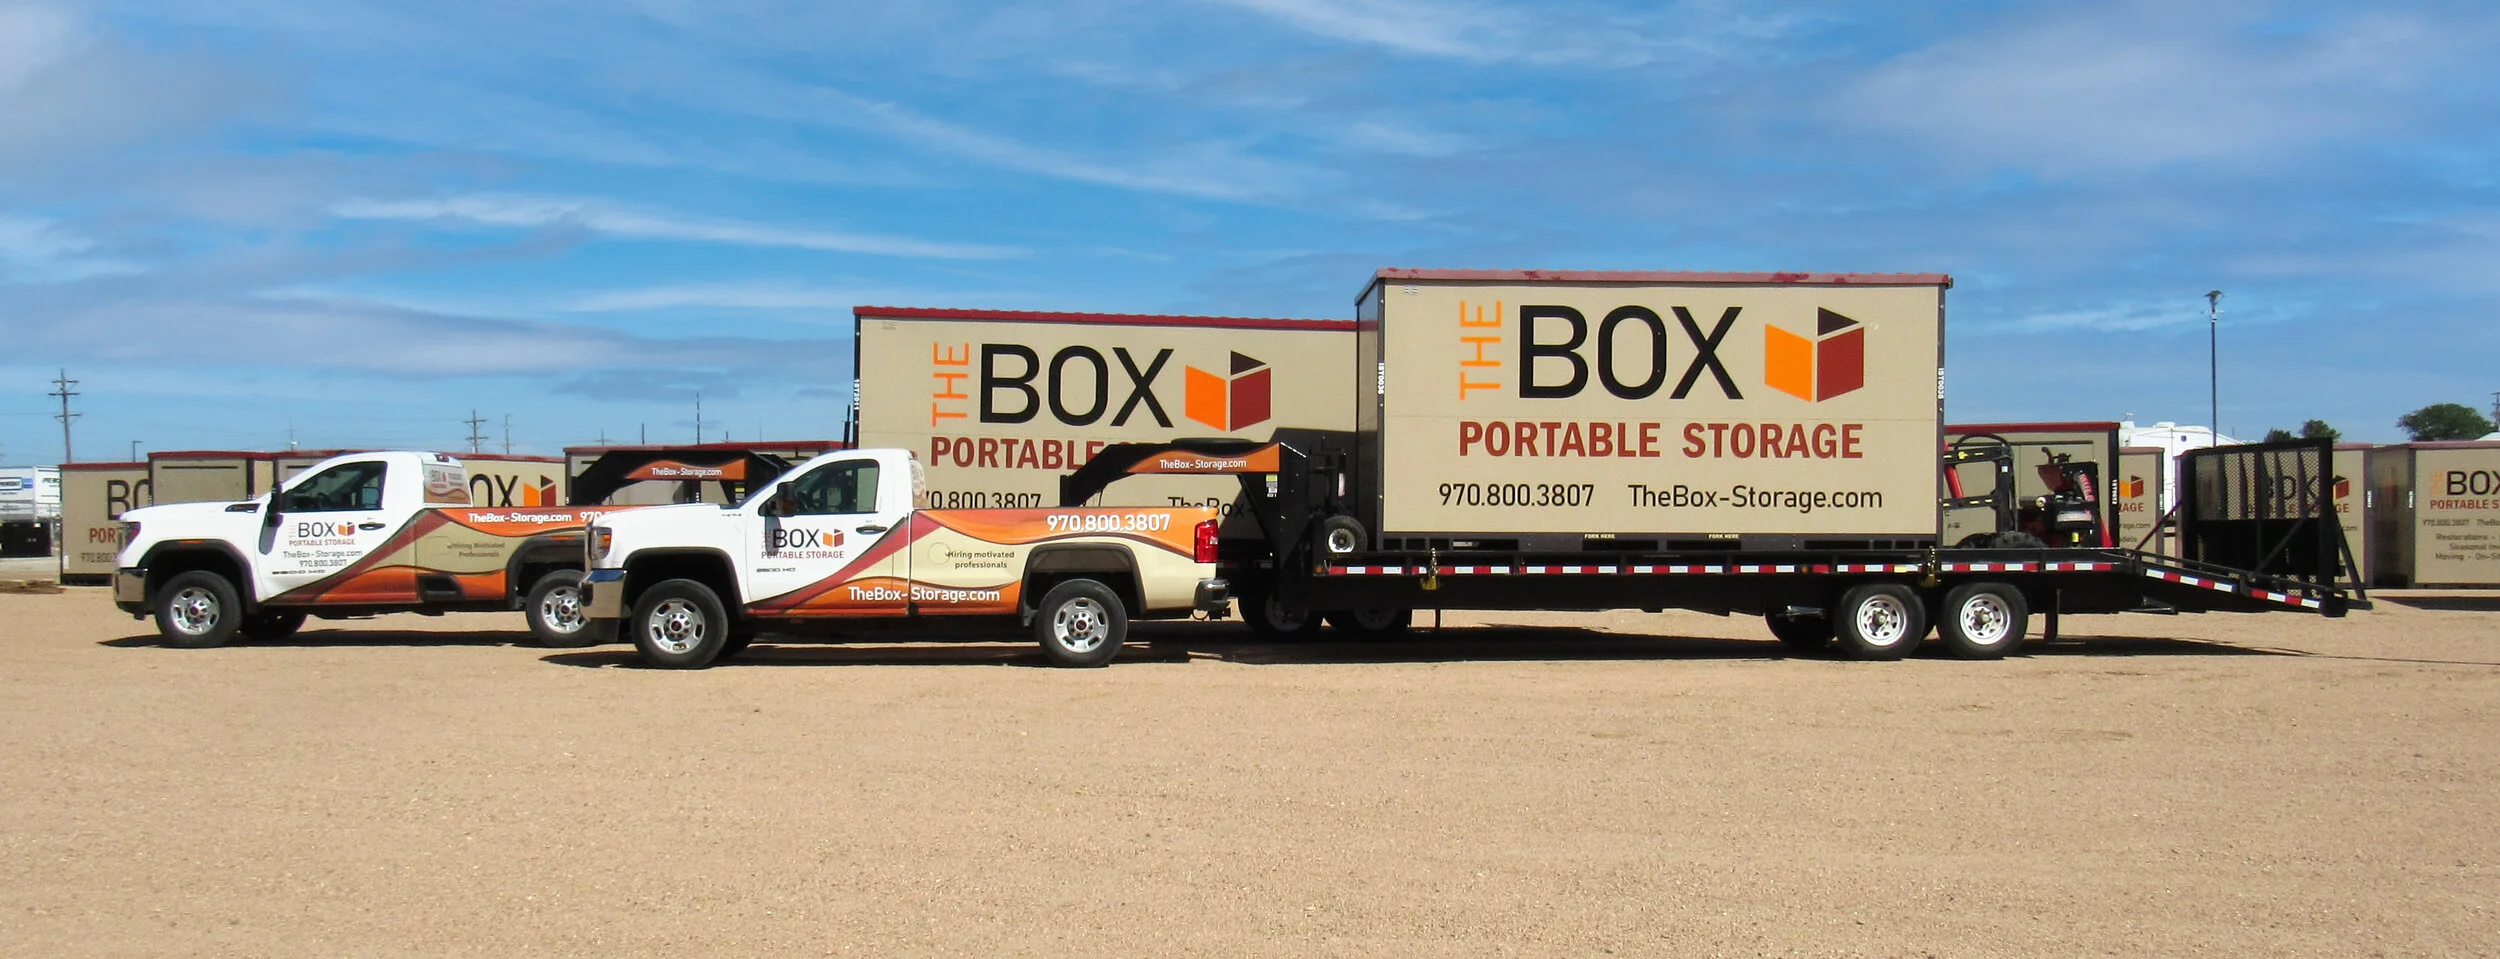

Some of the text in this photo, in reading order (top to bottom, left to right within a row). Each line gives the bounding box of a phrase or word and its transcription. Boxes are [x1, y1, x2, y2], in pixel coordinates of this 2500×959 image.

[1460, 300, 1502, 401] THE
[1519, 305, 1743, 399] BOX
[932, 342, 969, 427] THE
[980, 343, 1174, 428] BOX
[1459, 421, 1864, 459] PORTABLE STORAGE
[926, 490, 1042, 509] 0.800.3807
[1438, 483, 1883, 514] 970.800.3807 TheBox-Storage.com
[2430, 500, 2489, 510] PORTABLE
[298, 522, 336, 538] BOX
[1046, 513, 1171, 532] 970.800.3807
[289, 539, 323, 547] PORTABLE
[773, 528, 820, 548] BOX
[761, 551, 844, 559] PORTABLE STORAGE
[954, 560, 1008, 570] professionals
[848, 585, 1001, 603] TheBox-Storage.com
